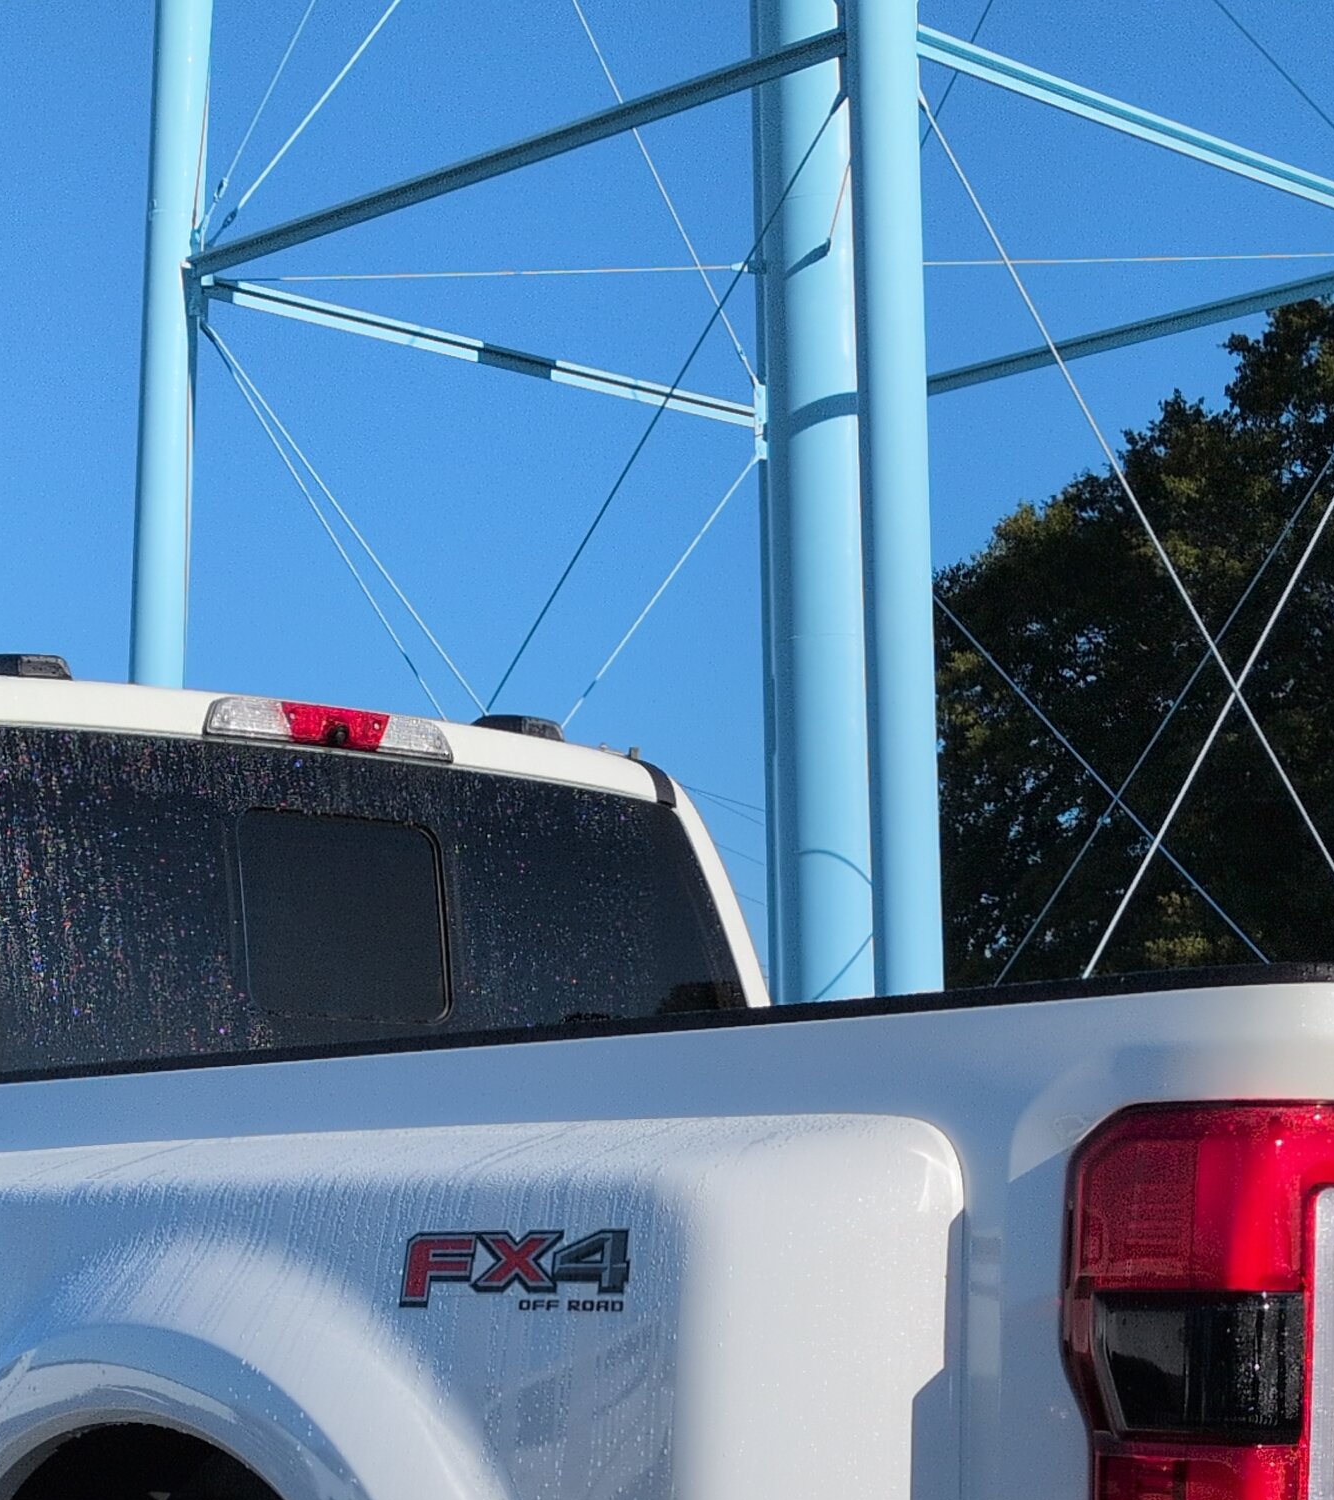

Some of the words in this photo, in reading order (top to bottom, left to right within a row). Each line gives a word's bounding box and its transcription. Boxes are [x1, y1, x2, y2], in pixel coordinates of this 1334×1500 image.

[398, 1229, 630, 1308] FX4
[518, 1299, 560, 1312] OFF
[567, 1299, 624, 1312] ROAD
